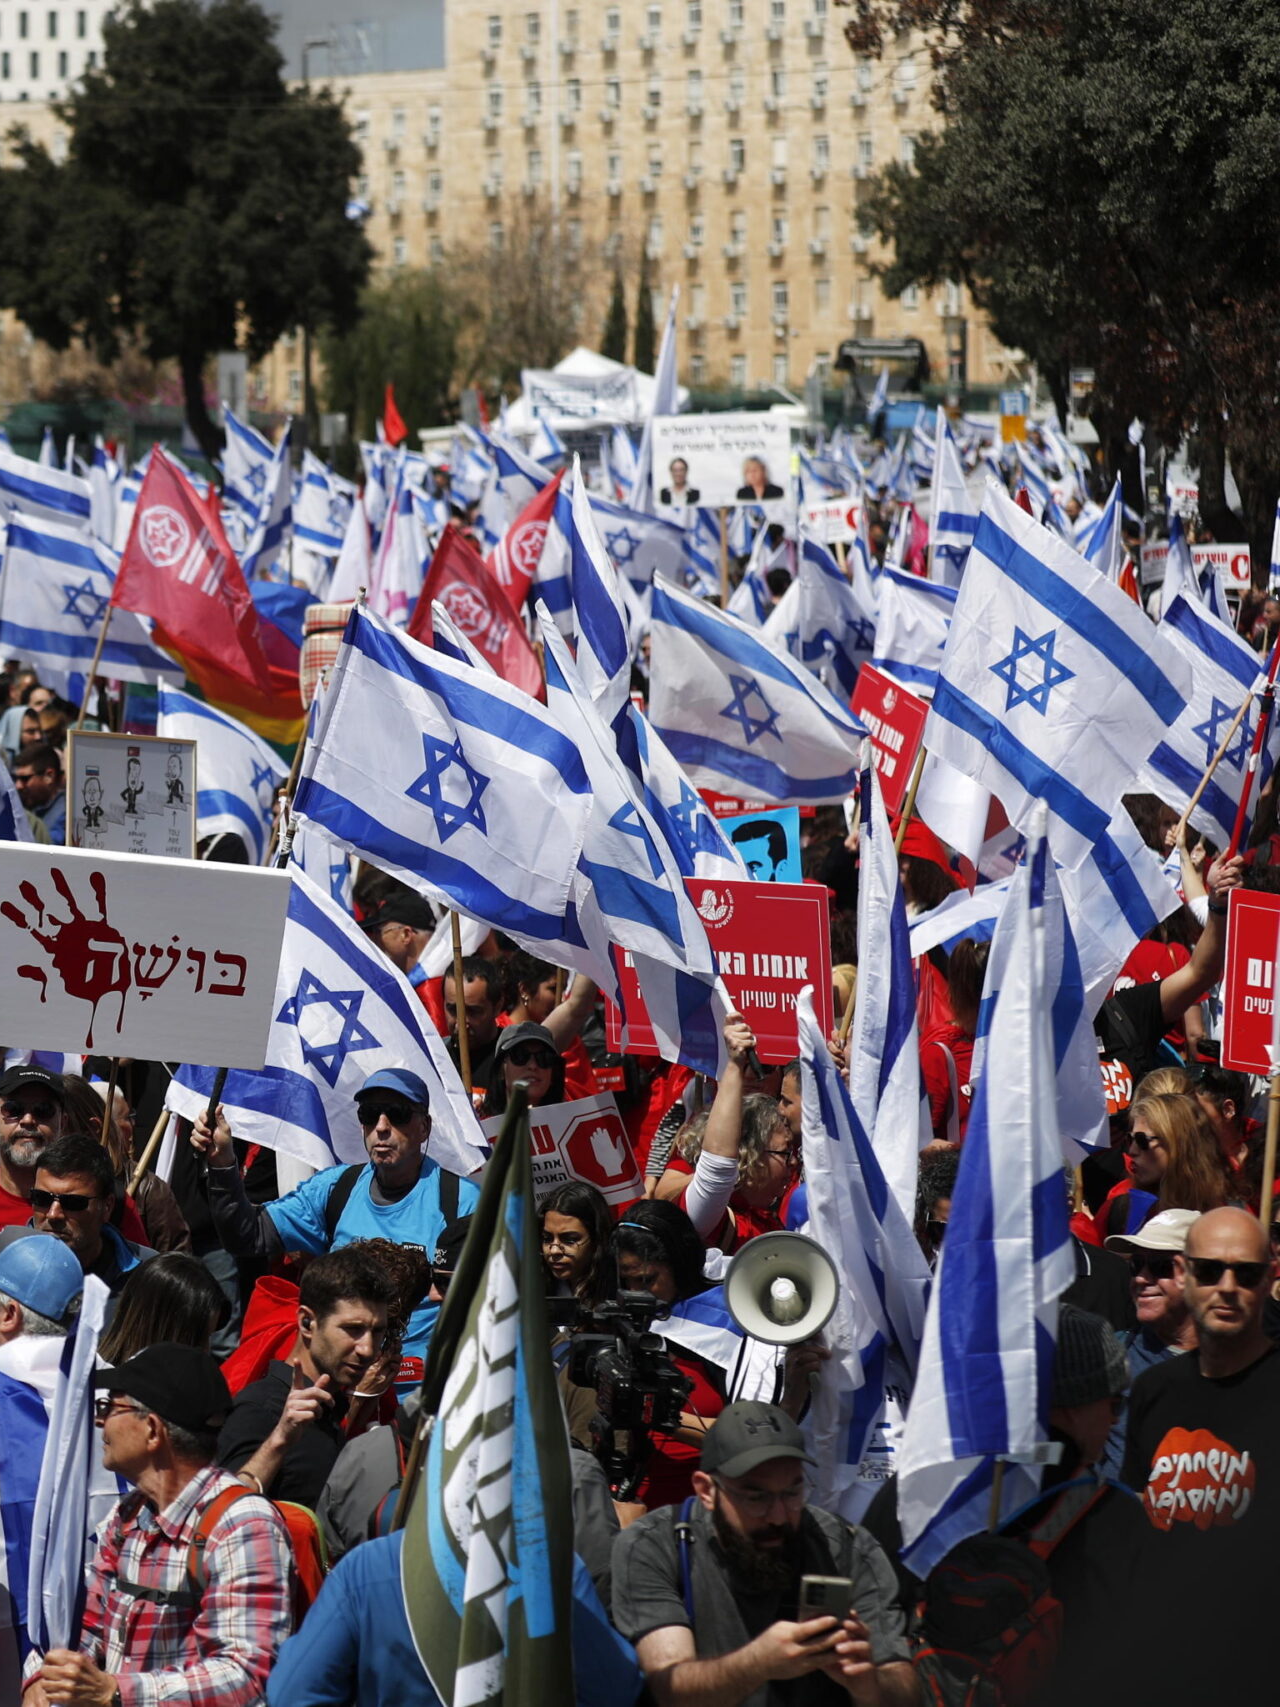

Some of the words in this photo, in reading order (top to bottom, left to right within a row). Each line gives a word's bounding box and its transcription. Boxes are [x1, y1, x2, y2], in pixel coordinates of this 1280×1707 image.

[753, 953, 808, 980] אנחנו
[741, 990, 776, 1010] שוויון
[544, 1158, 562, 1171] את
[1148, 1448, 1249, 1488] מושחתים
